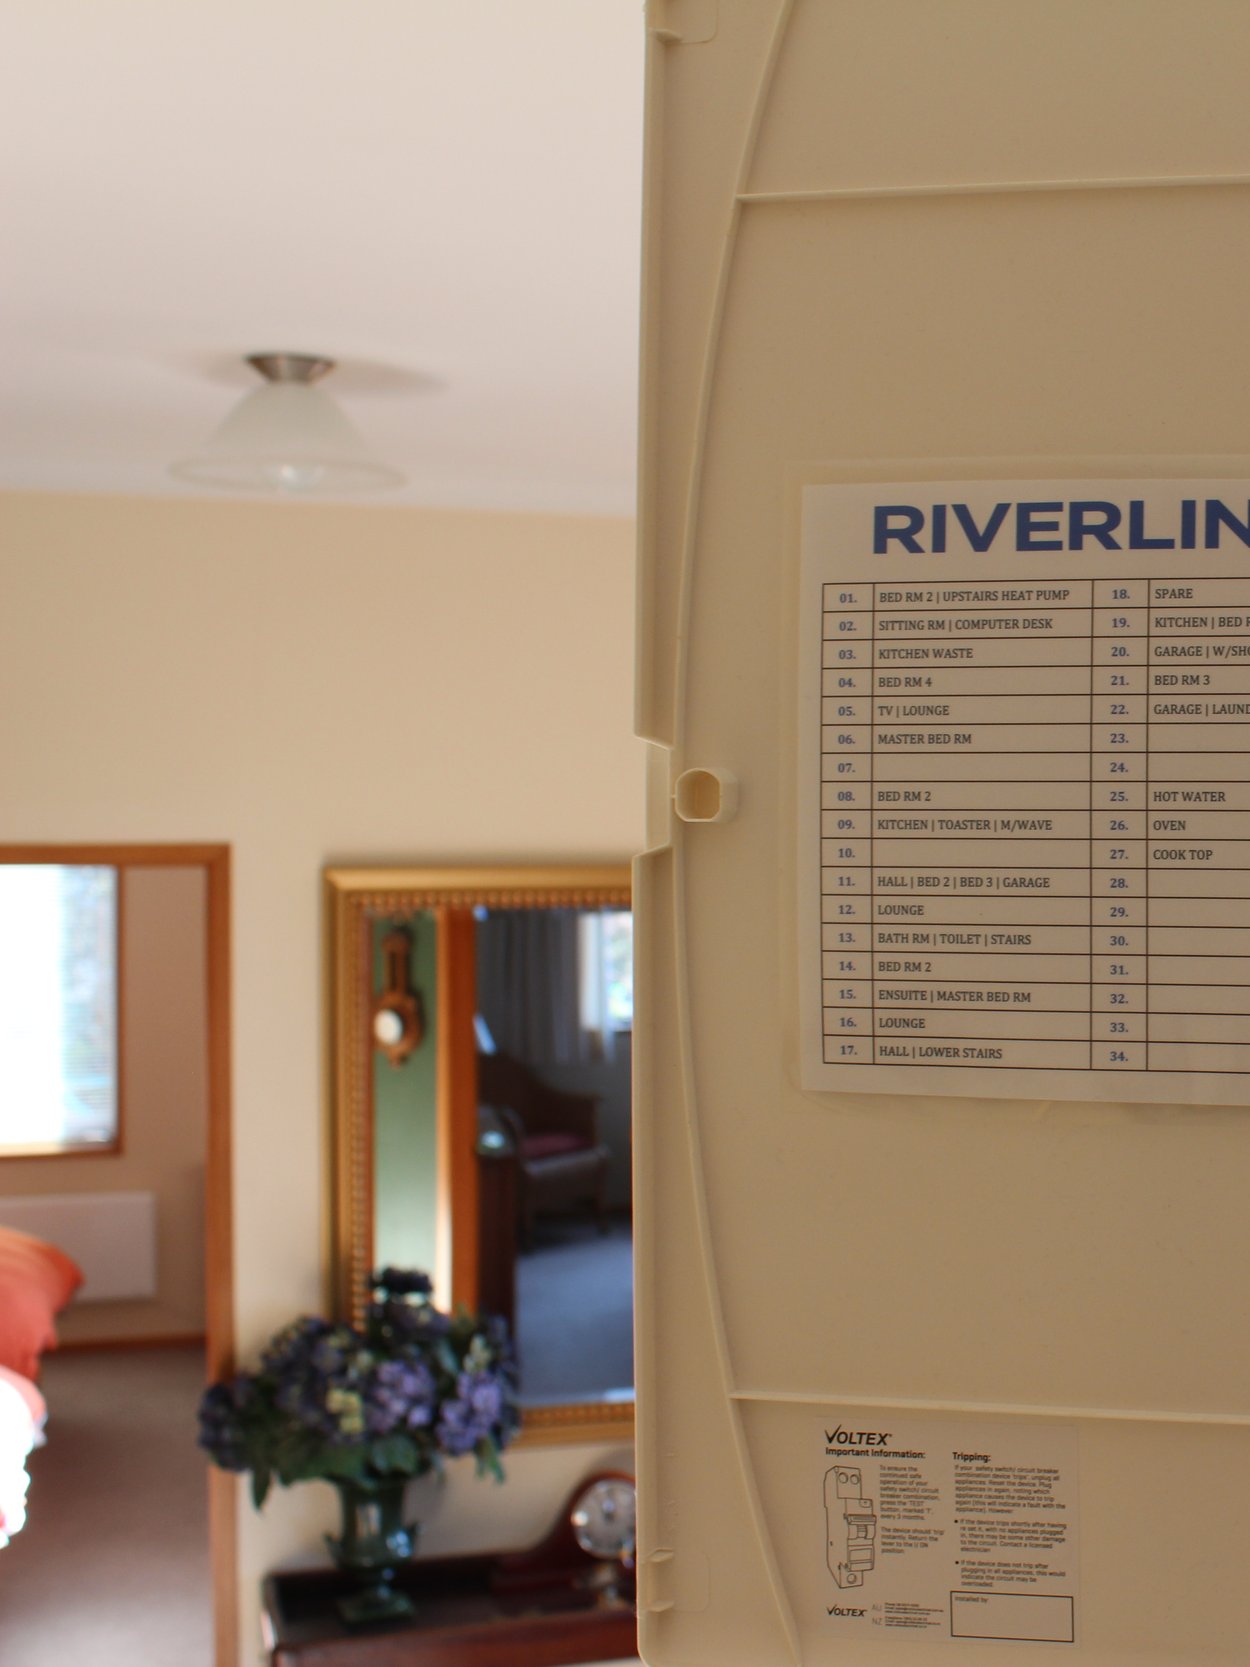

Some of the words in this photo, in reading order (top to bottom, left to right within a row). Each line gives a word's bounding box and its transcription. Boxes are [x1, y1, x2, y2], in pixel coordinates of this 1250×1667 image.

[839, 592, 858, 604] 01.
[879, 591, 903, 603] BED
[905, 591, 923, 602] RM
[926, 591, 933, 602] 2
[942, 590, 999, 602] UPSTAIRS
[1001, 590, 1034, 601] HEAT
[1035, 589, 1070, 601] PUMP
[1112, 588, 1130, 600] 18.
[1154, 587, 1193, 599] SPARE
[838, 620, 857, 632] 02.
[878, 619, 925, 631] SITTING
[927, 619, 945, 630] RM
[954, 619, 1020, 630] COMPUTER
[1022, 618, 1053, 629] DESK
[1111, 617, 1130, 628] 19.
[1154, 616, 1208, 628] KITCHEN
[1218, 616, 1243, 627] BED
[838, 649, 856, 660] 03.
[878, 648, 929, 660] KITCHEN
[931, 647, 973, 659] WASTE
[1110, 646, 1130, 657] 20.
[1153, 645, 1203, 657] GARAGE
[838, 677, 856, 688] 04.
[878, 676, 902, 688] BED
[904, 676, 922, 687] RM
[924, 676, 933, 687] 4
[1110, 675, 1129, 686] 21.
[1154, 674, 1179, 686] BED
[1181, 674, 1200, 685] RM
[1202, 674, 1210, 685] 3
[837, 705, 856, 716] 05.
[877, 705, 894, 716] TV
[902, 704, 950, 716] LOUNGE
[1110, 704, 1129, 715] 22.
[1153, 703, 1202, 715] GARAGE
[837, 734, 856, 745] 06.
[877, 733, 925, 744] MASTER
[927, 733, 951, 744] BED
[953, 733, 972, 744] RM
[837, 790, 855, 802] 08.
[877, 790, 901, 802] BED
[903, 790, 922, 802] RM
[924, 790, 931, 802] 2
[1109, 791, 1129, 802] 25.
[1153, 791, 1180, 802] HOT
[1180, 791, 1226, 802] WATER
[836, 819, 855, 830] 09.
[877, 819, 928, 830] KITCHEN
[937, 819, 991, 830] TOASTER
[1000, 819, 1053, 832] M/WAVE
[1109, 819, 1129, 831] 26.
[1152, 819, 1186, 831] OVEN
[1109, 848, 1128, 860] 27.
[1152, 849, 1187, 860] COOK
[1188, 849, 1213, 860] TOP
[838, 876, 855, 887] 11.
[877, 876, 908, 887] HALL
[917, 876, 941, 887] BED
[942, 876, 950, 887] 2
[959, 876, 984, 888] BED
[985, 876, 993, 888] 3
[1002, 876, 1050, 888] GARAGE
[838, 904, 856, 915] 12.
[877, 904, 924, 916] LOUNGE
[838, 932, 856, 943] 13.
[877, 932, 909, 944] BATH
[911, 932, 930, 944] RM
[938, 933, 982, 945] TOILET
[990, 933, 1032, 945] STAIRS
[839, 960, 856, 971] 14.
[877, 960, 902, 972] BED
[903, 961, 922, 972] RM
[924, 961, 932, 972] 2
[839, 988, 856, 1000] 15.
[878, 989, 927, 1001] ENSUITE
[936, 990, 984, 1002] MASTER
[986, 991, 1010, 1002] BED
[1012, 991, 1031, 1003] RM
[839, 1016, 857, 1027] 16.
[878, 1017, 926, 1029] LOUNGE
[840, 1044, 858, 1055] 17.
[879, 1045, 910, 1057] HALL
[918, 1046, 960, 1058] LOWER
[962, 1047, 1002, 1059] STAIRS
[826, 1447, 869, 1457] Important
[871, 1449, 926, 1459] Information:
[952, 1452, 991, 1463] Tripping:
